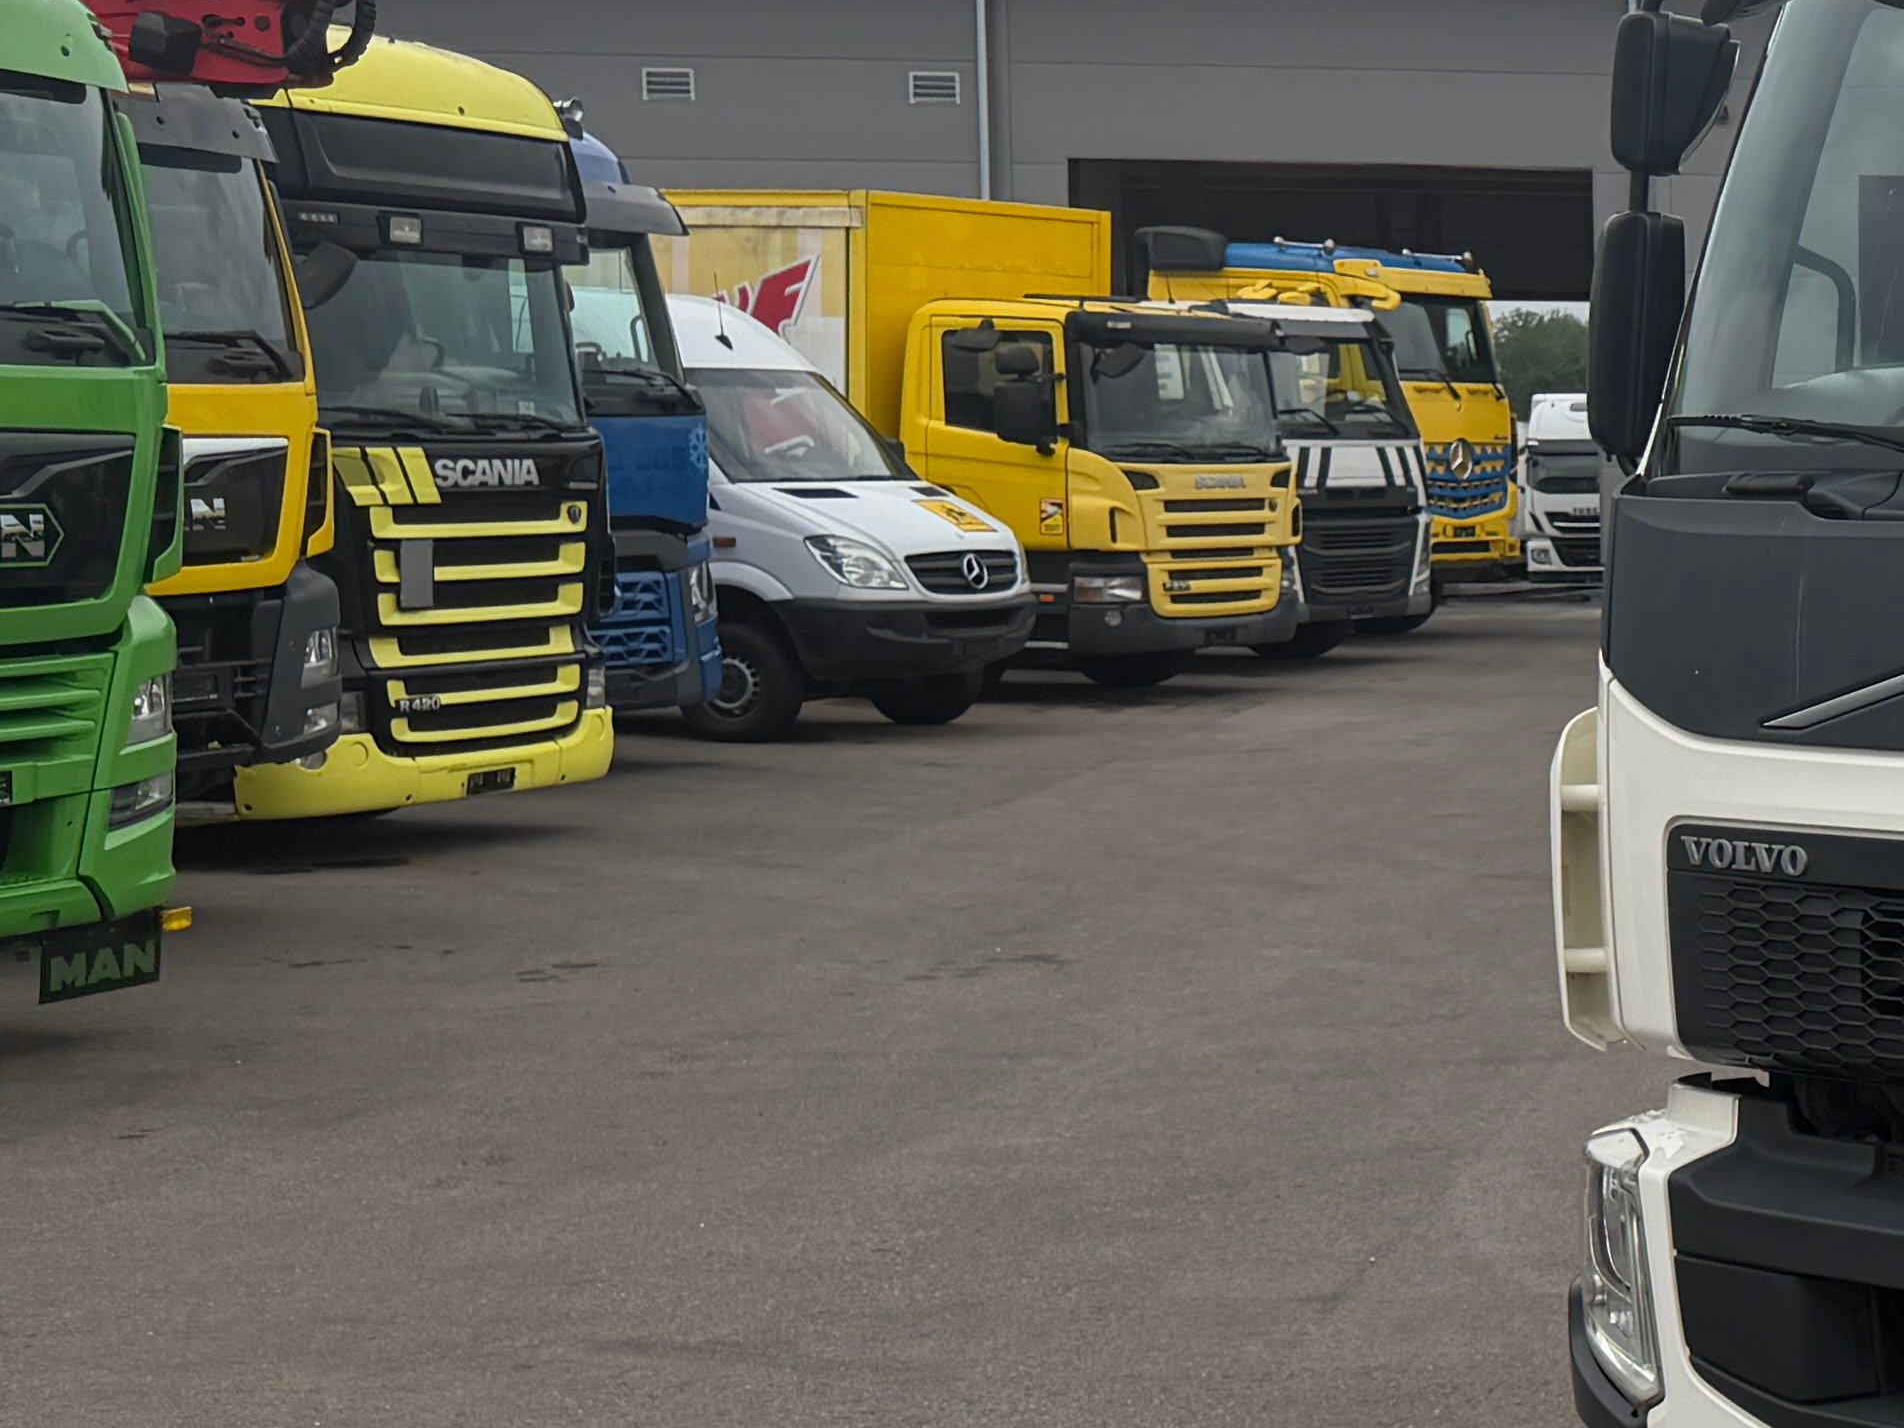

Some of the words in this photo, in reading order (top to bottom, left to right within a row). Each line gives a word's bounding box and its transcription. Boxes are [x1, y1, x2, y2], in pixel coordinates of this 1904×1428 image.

[434, 458, 540, 488] SCANIA
[1680, 835, 1808, 876] VOLVO
[49, 938, 157, 993] MAN
